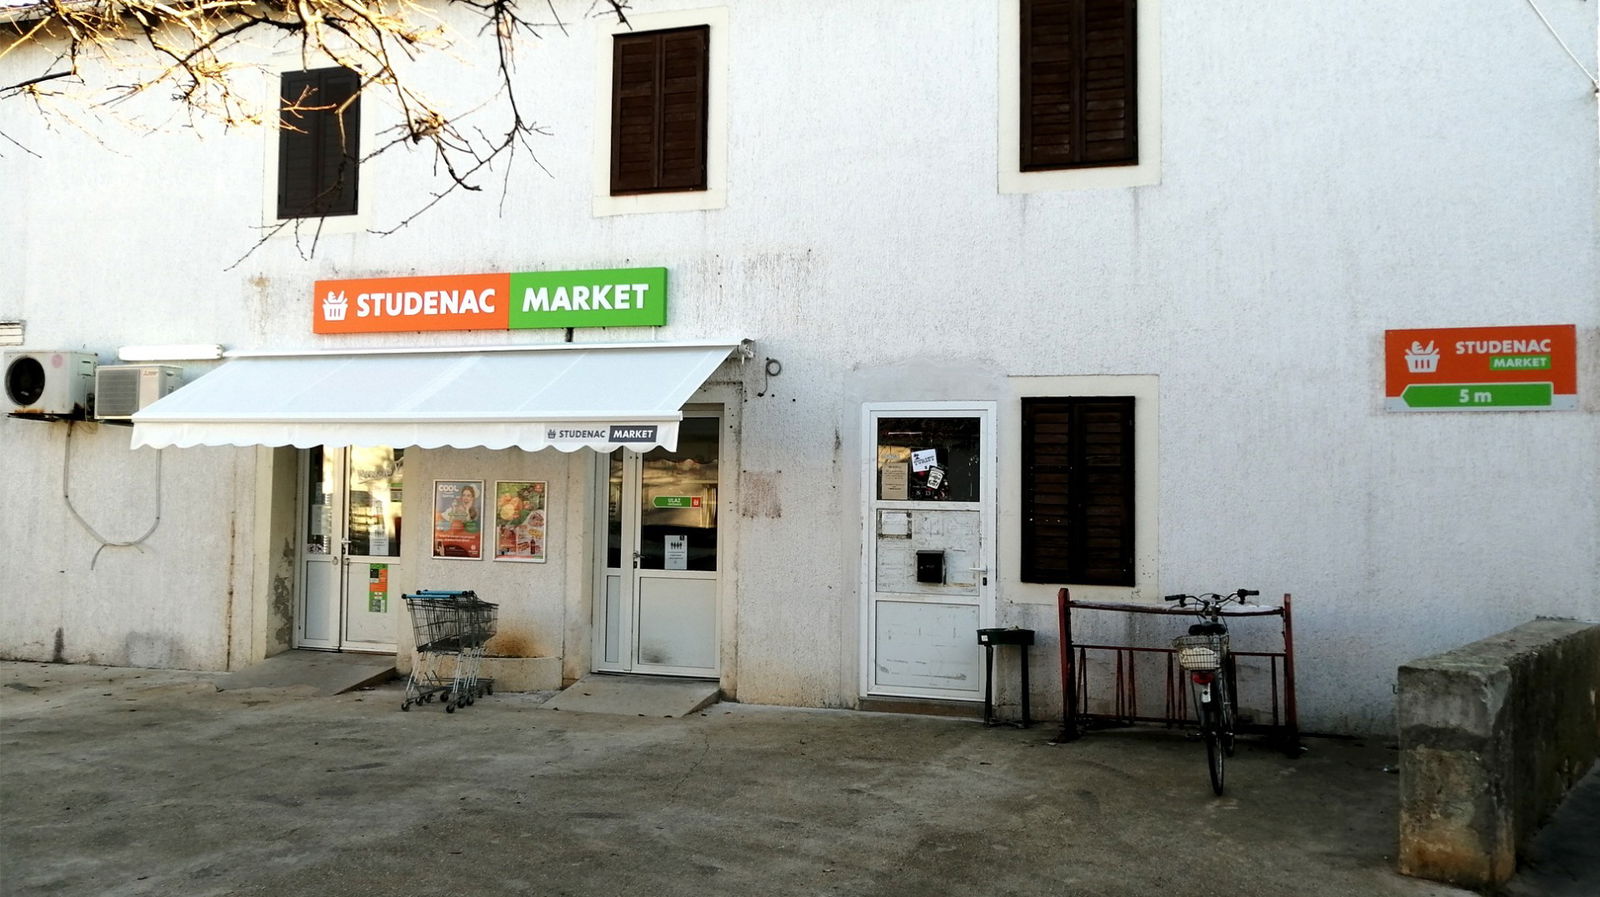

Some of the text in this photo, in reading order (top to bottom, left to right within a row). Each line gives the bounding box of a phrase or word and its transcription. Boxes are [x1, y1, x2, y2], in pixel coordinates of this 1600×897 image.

[356, 283, 649, 318] STUDENAC MARKET
[1455, 339, 1552, 354] STUDENAC
[1493, 357, 1548, 368] MARKET
[1459, 389, 1492, 403] 5 m
[559, 429, 654, 439] STUDENAC MARKET
[438, 484, 459, 492] COOL
